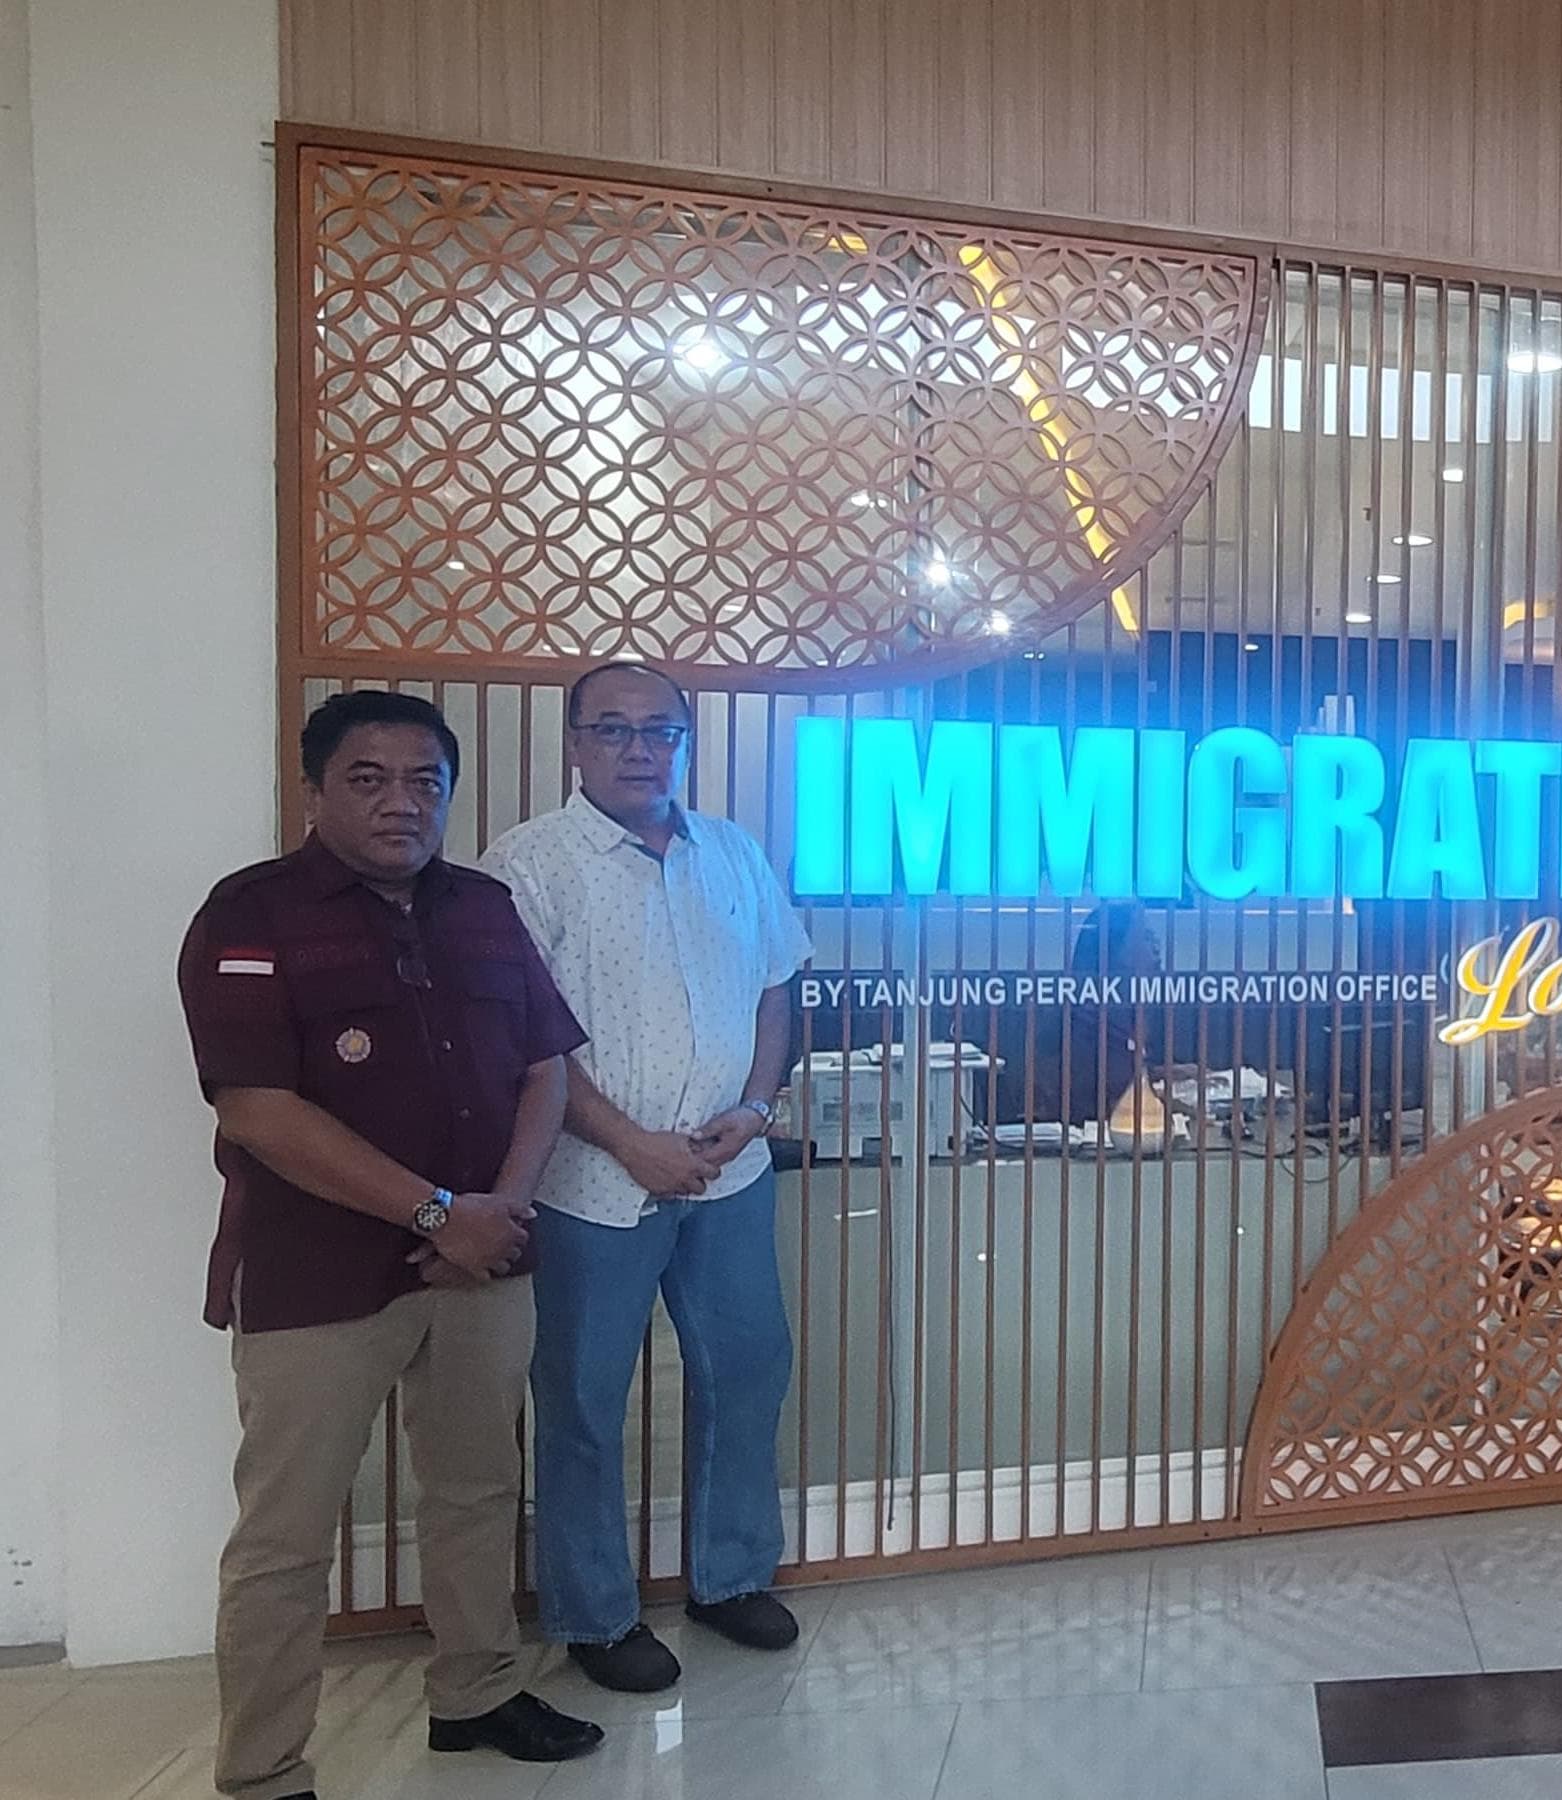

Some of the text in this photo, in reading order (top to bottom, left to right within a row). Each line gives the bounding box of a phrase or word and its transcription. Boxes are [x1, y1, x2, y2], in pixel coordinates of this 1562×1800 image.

[801, 973, 1438, 1008] BY TANJUNG PERAK IMMIGRATION OFFICE
